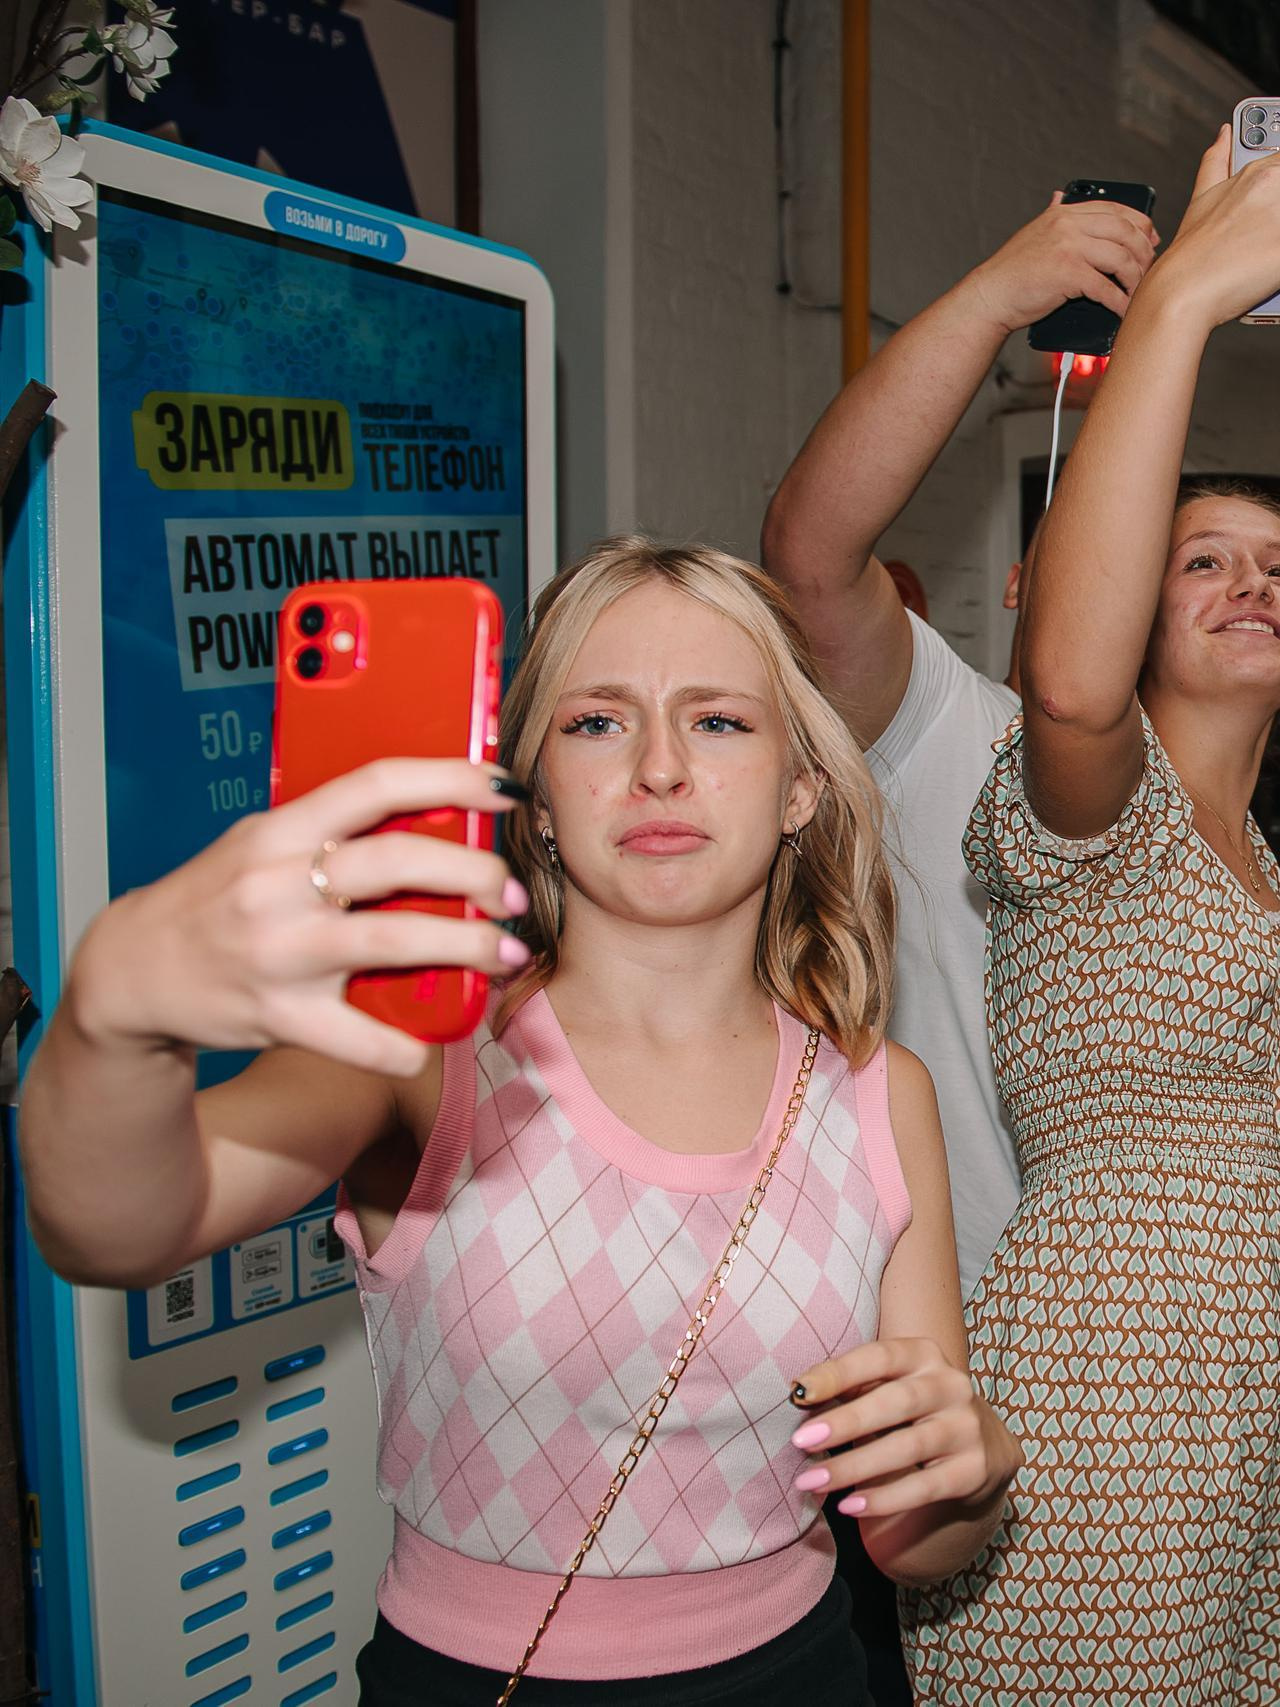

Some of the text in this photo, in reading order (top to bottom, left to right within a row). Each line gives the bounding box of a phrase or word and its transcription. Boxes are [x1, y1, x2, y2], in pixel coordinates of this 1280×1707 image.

[212, 0, 347, 48] ЕР-БАР
[285, 206, 388, 248] ВОЗЬМИ В ДОРОГУ
[154, 402, 506, 492] ЗАРЯДИ ТЕЛЕФОН
[183, 529, 501, 593] АВТОМАТ ВЫДАЕТ
[188, 610, 283, 674] POW
[200, 709, 243, 760] 50
[207, 777, 248, 812] 100
